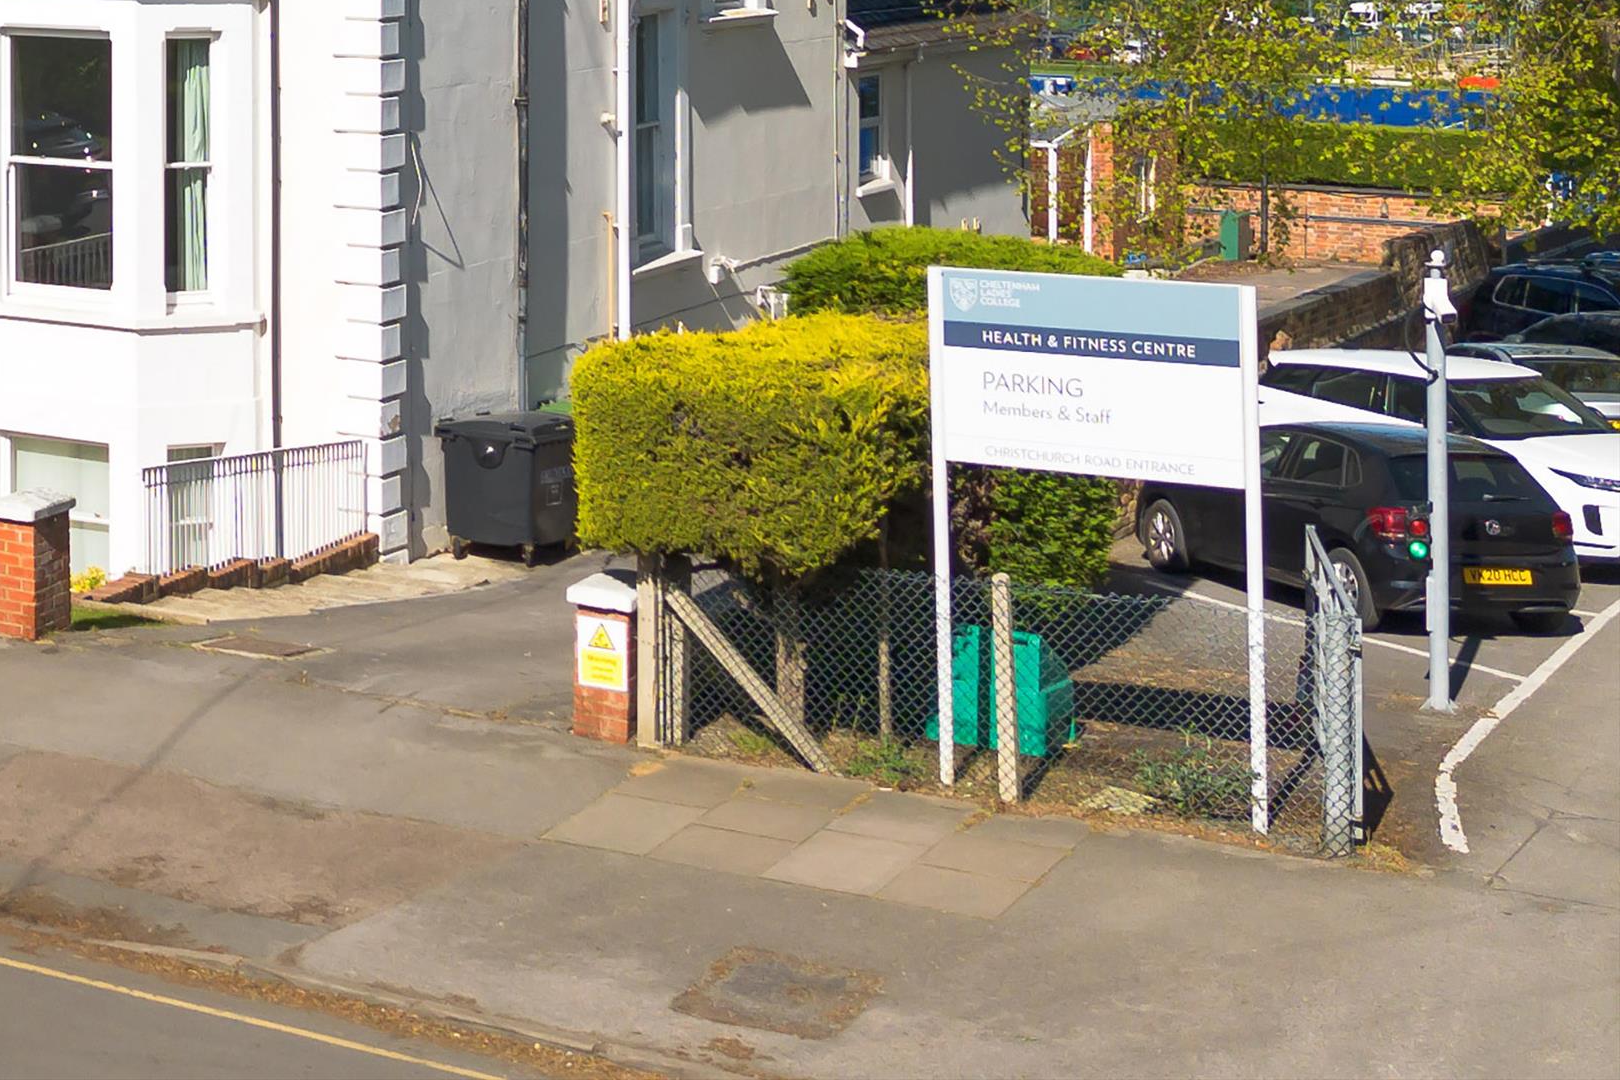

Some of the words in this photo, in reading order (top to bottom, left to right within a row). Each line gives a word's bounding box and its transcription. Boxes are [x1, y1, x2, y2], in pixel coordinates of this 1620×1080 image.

[980, 280, 1040, 291] CHELTENHAM
[980, 297, 1021, 308] COLLEGE
[982, 330, 1042, 347] HEALTH
[1047, 335, 1058, 348] &
[1063, 336, 1127, 353] FITNESS
[1131, 340, 1196, 358] CENTRE
[983, 371, 1084, 398] PARKING
[983, 400, 1053, 420] Members
[1058, 406, 1070, 421] &
[1076, 406, 1111, 425] Staff
[985, 445, 1079, 465] CHRISTCHURCH
[1084, 454, 1121, 469] ROAD
[1126, 458, 1195, 476] ENTRANCE
